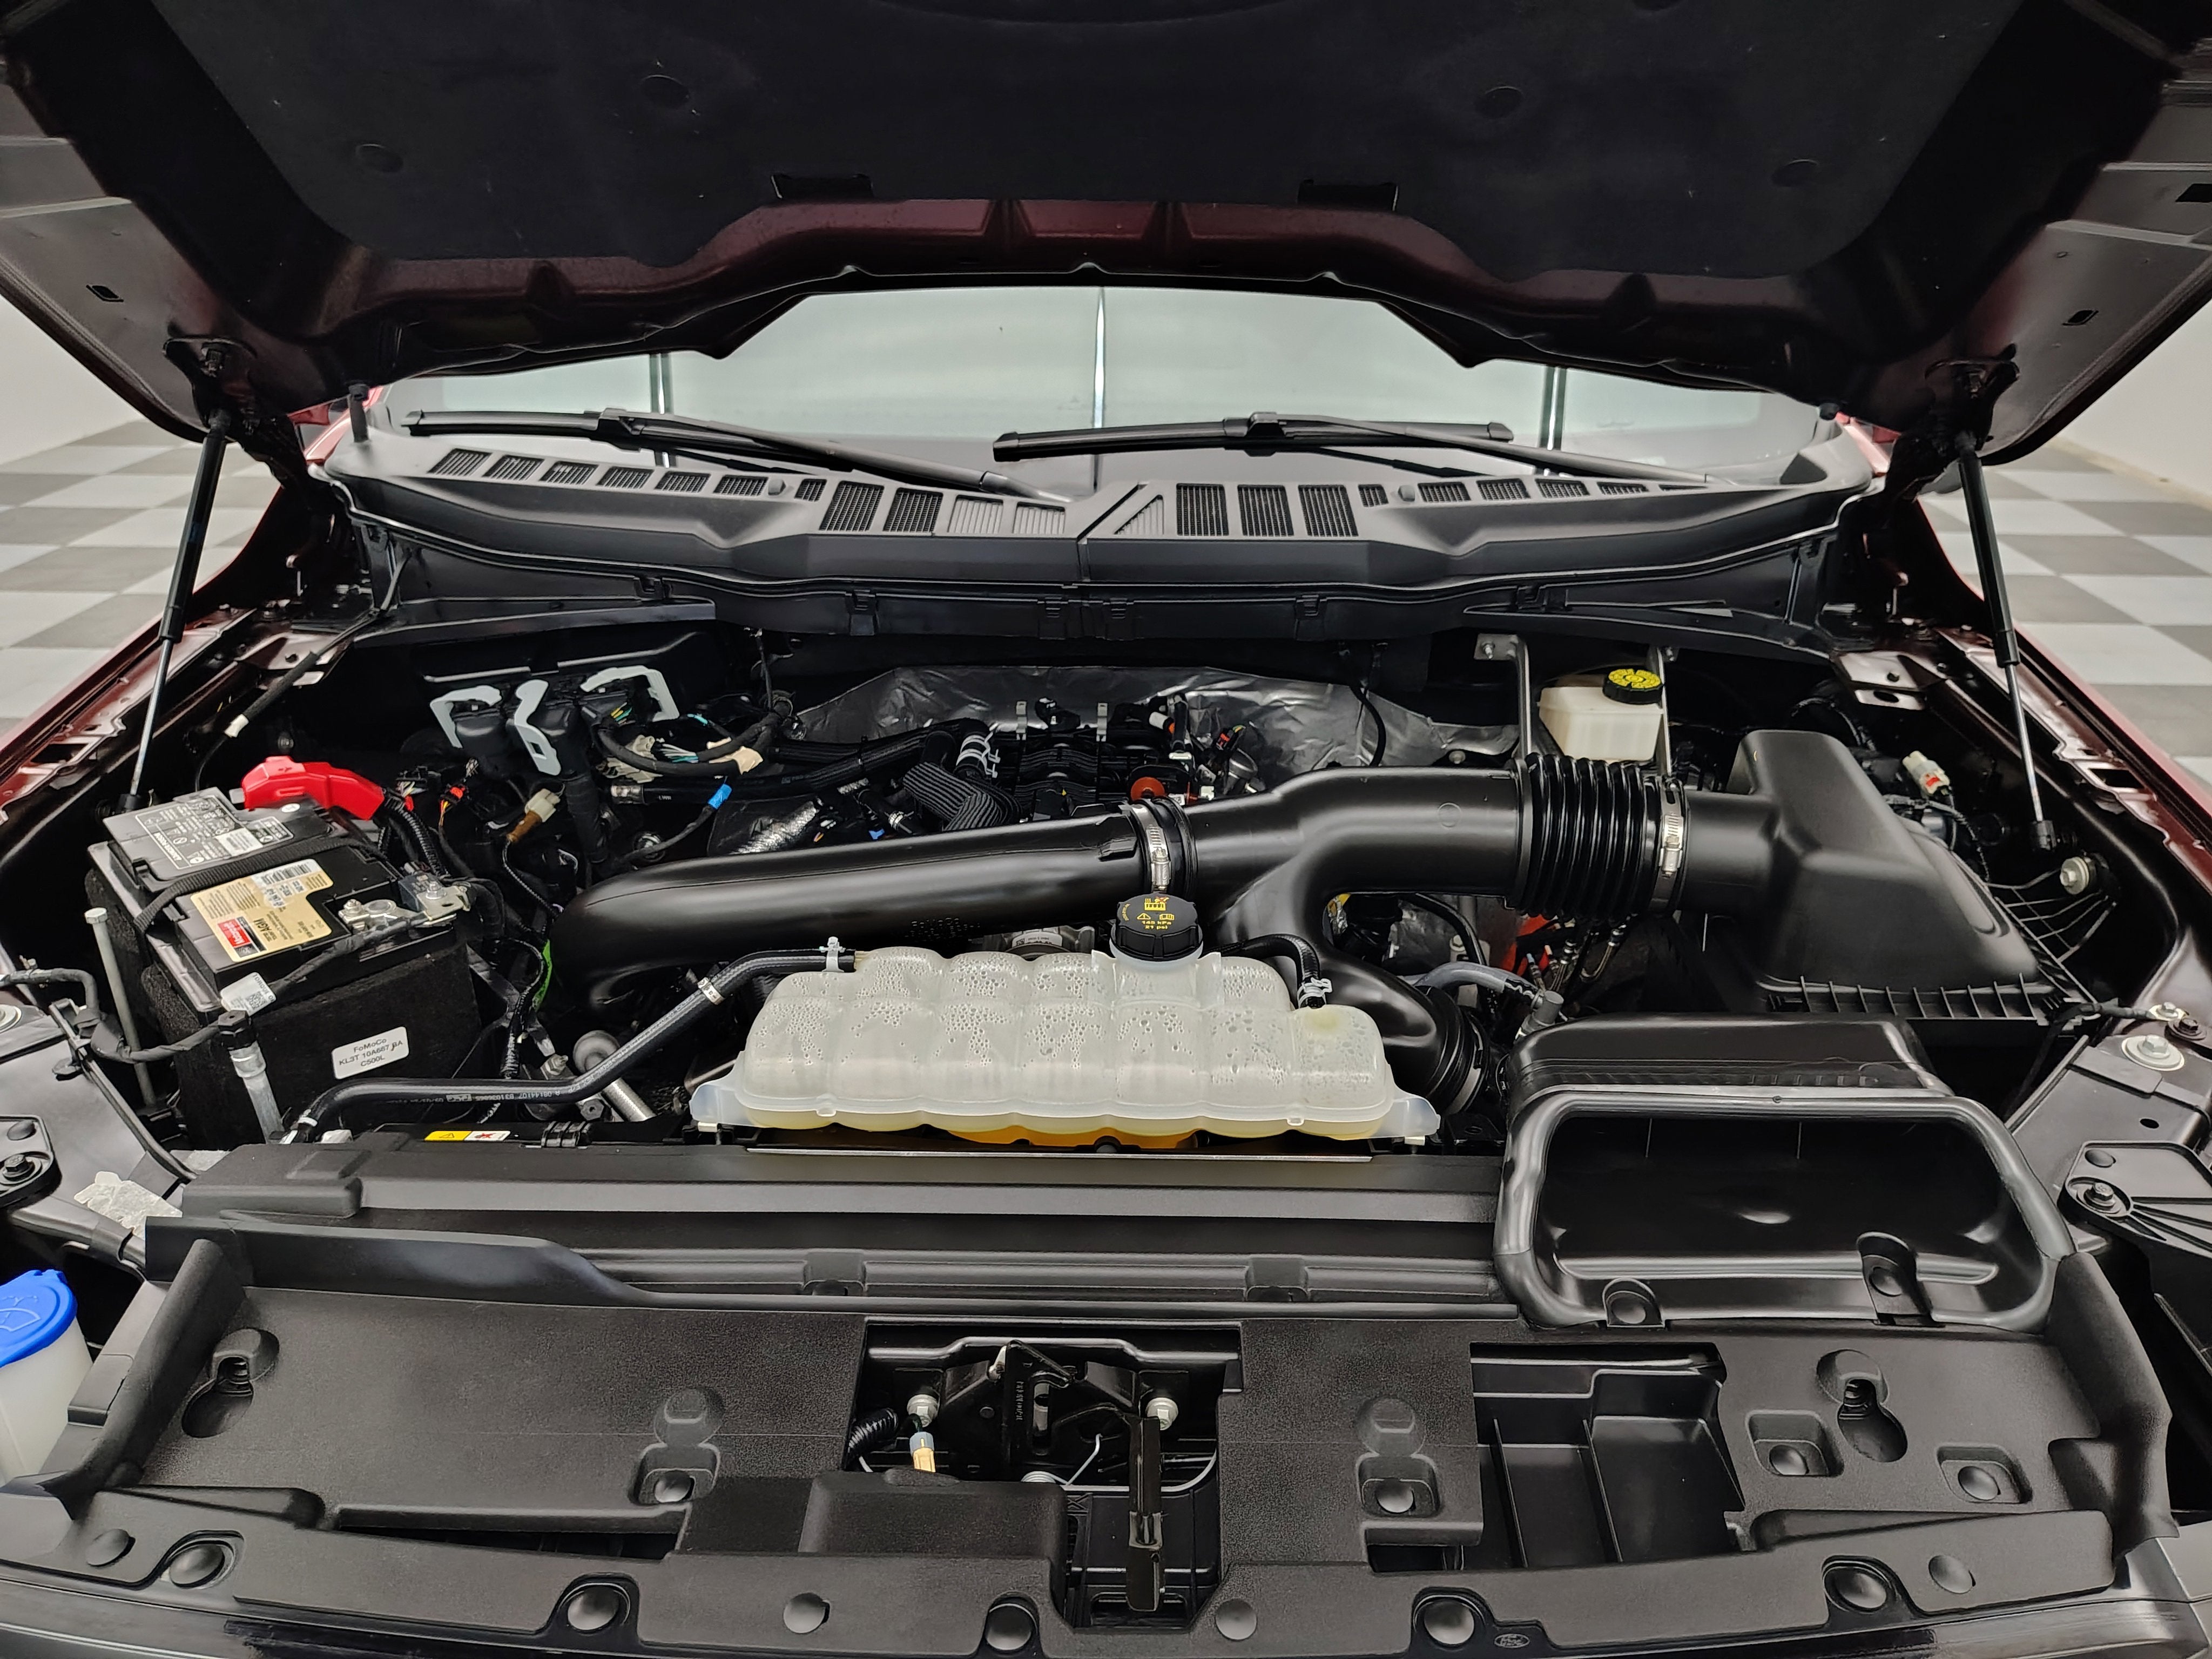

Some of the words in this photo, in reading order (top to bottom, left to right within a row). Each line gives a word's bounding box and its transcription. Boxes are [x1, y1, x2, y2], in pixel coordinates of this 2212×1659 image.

[354, 1038, 387, 1053] FoMoCo
[339, 1054, 360, 1065] KL3T
[361, 1055, 386, 1067] C500L
